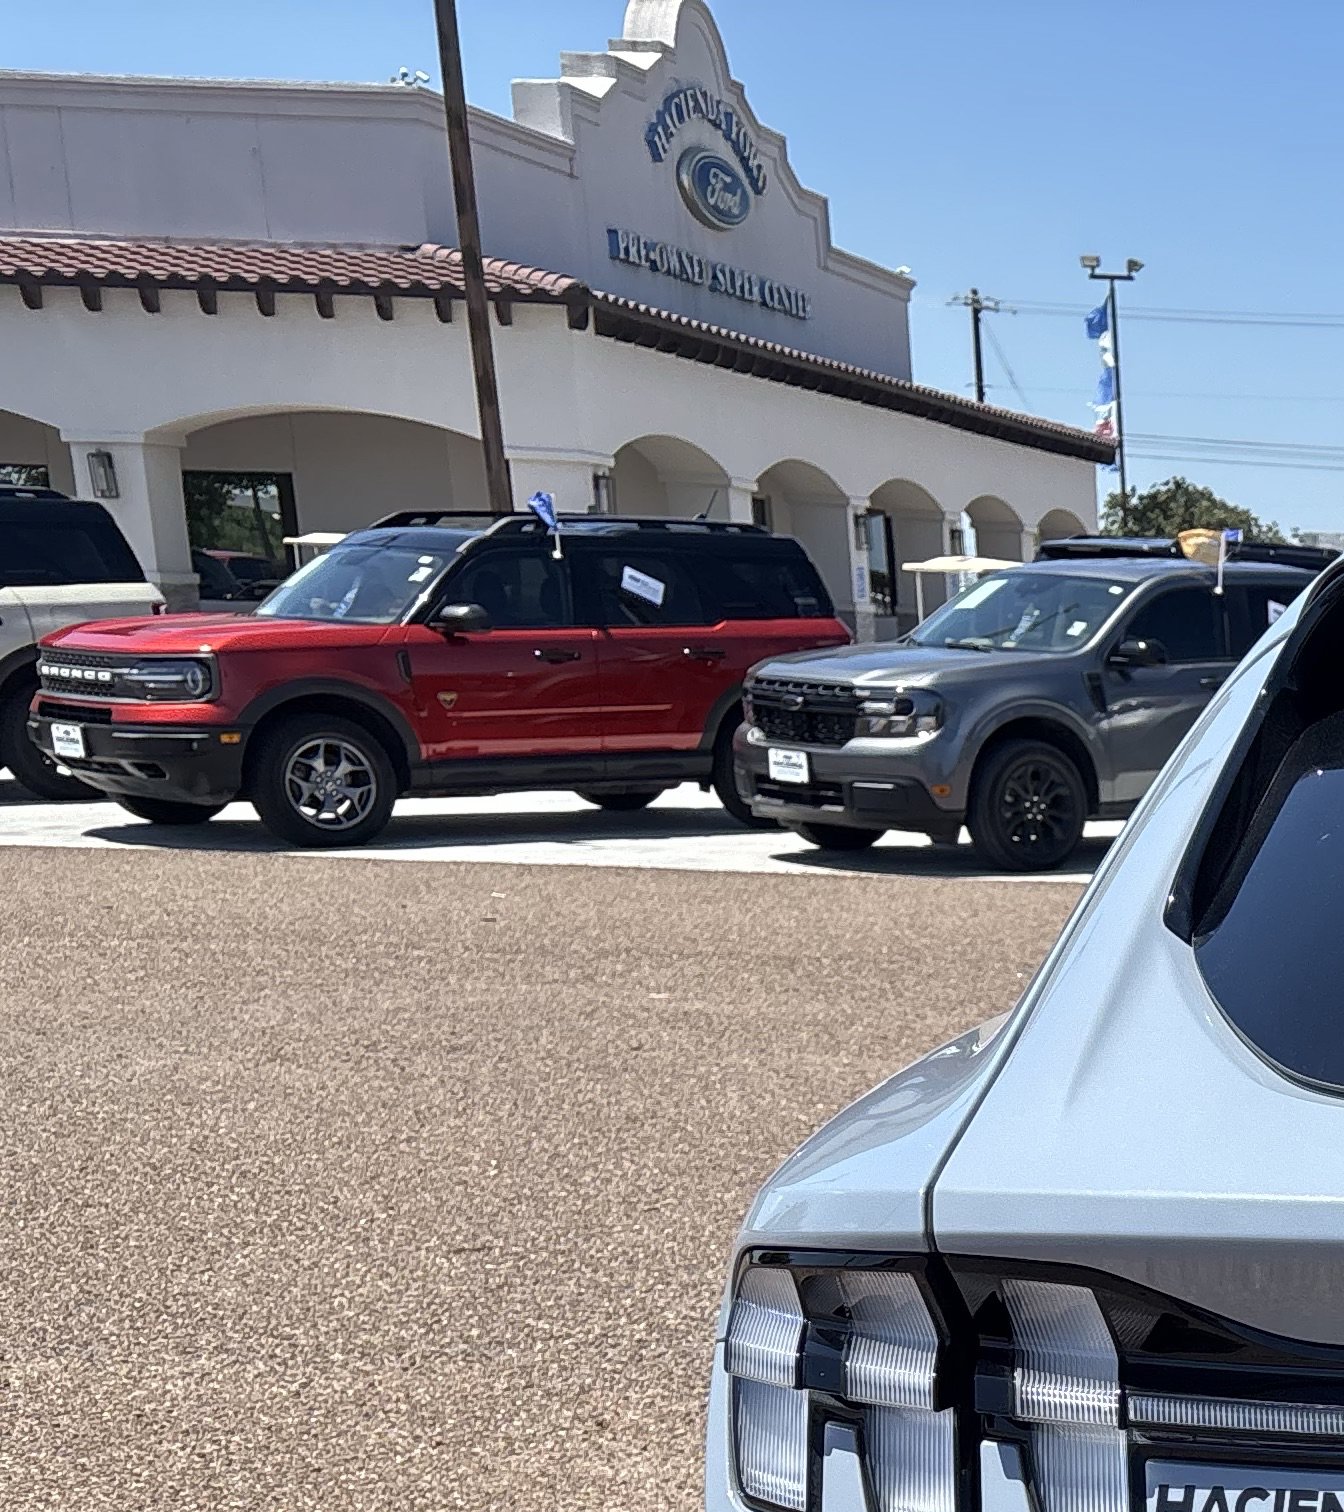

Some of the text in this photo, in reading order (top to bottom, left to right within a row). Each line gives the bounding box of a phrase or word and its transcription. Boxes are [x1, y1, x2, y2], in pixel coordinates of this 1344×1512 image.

[649, 88, 732, 161] HACIENDA
[705, 166, 742, 216] Ford
[611, 229, 712, 287] PRE-OWNED
[41, 665, 111, 681] BRONCO
